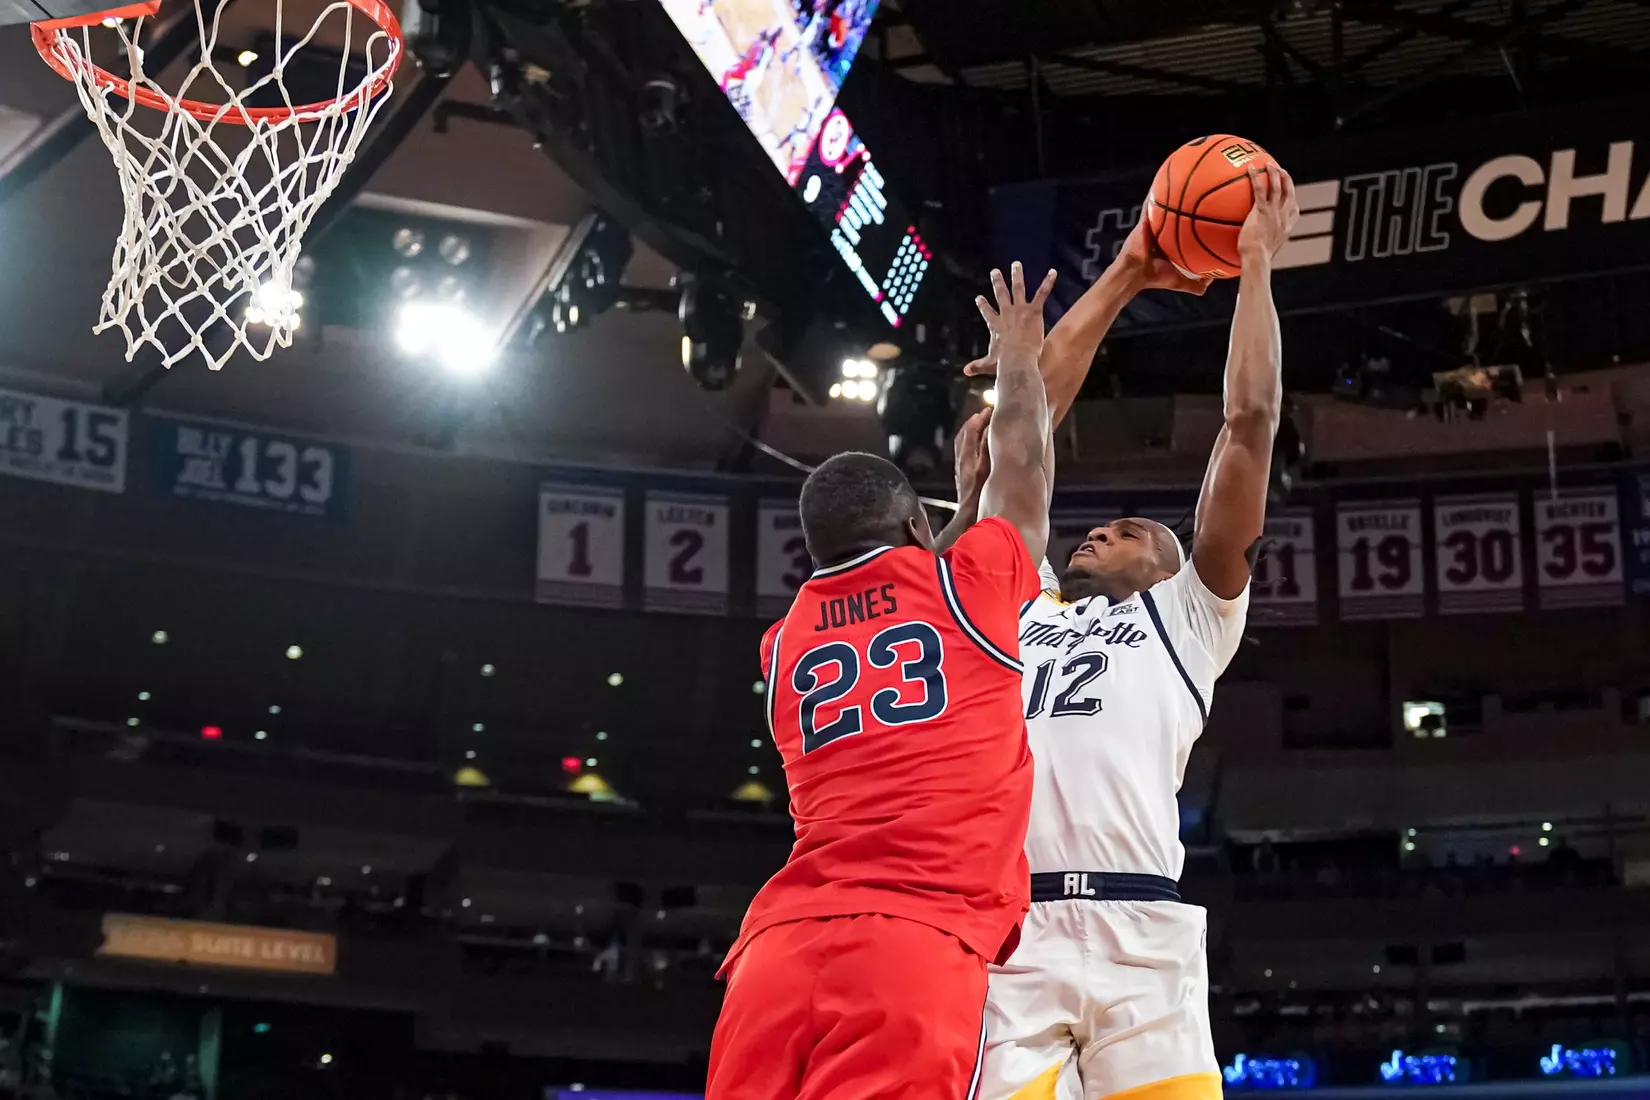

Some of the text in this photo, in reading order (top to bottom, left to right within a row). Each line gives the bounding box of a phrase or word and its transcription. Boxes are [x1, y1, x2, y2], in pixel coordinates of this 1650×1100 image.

[1343, 162, 1458, 262] THE
[1458, 140, 1650, 242] CH
[58, 408, 119, 466] 15
[234, 437, 333, 503] 133
[567, 522, 593, 576] 1
[669, 529, 704, 583] 2
[1351, 534, 1411, 590] 19
[1445, 529, 1514, 584] 30
[1542, 523, 1615, 579] 35
[815, 584, 898, 632] JONES
[792, 620, 948, 756] 23
[1025, 651, 1109, 719] 12
[1063, 873, 1096, 896] AL
